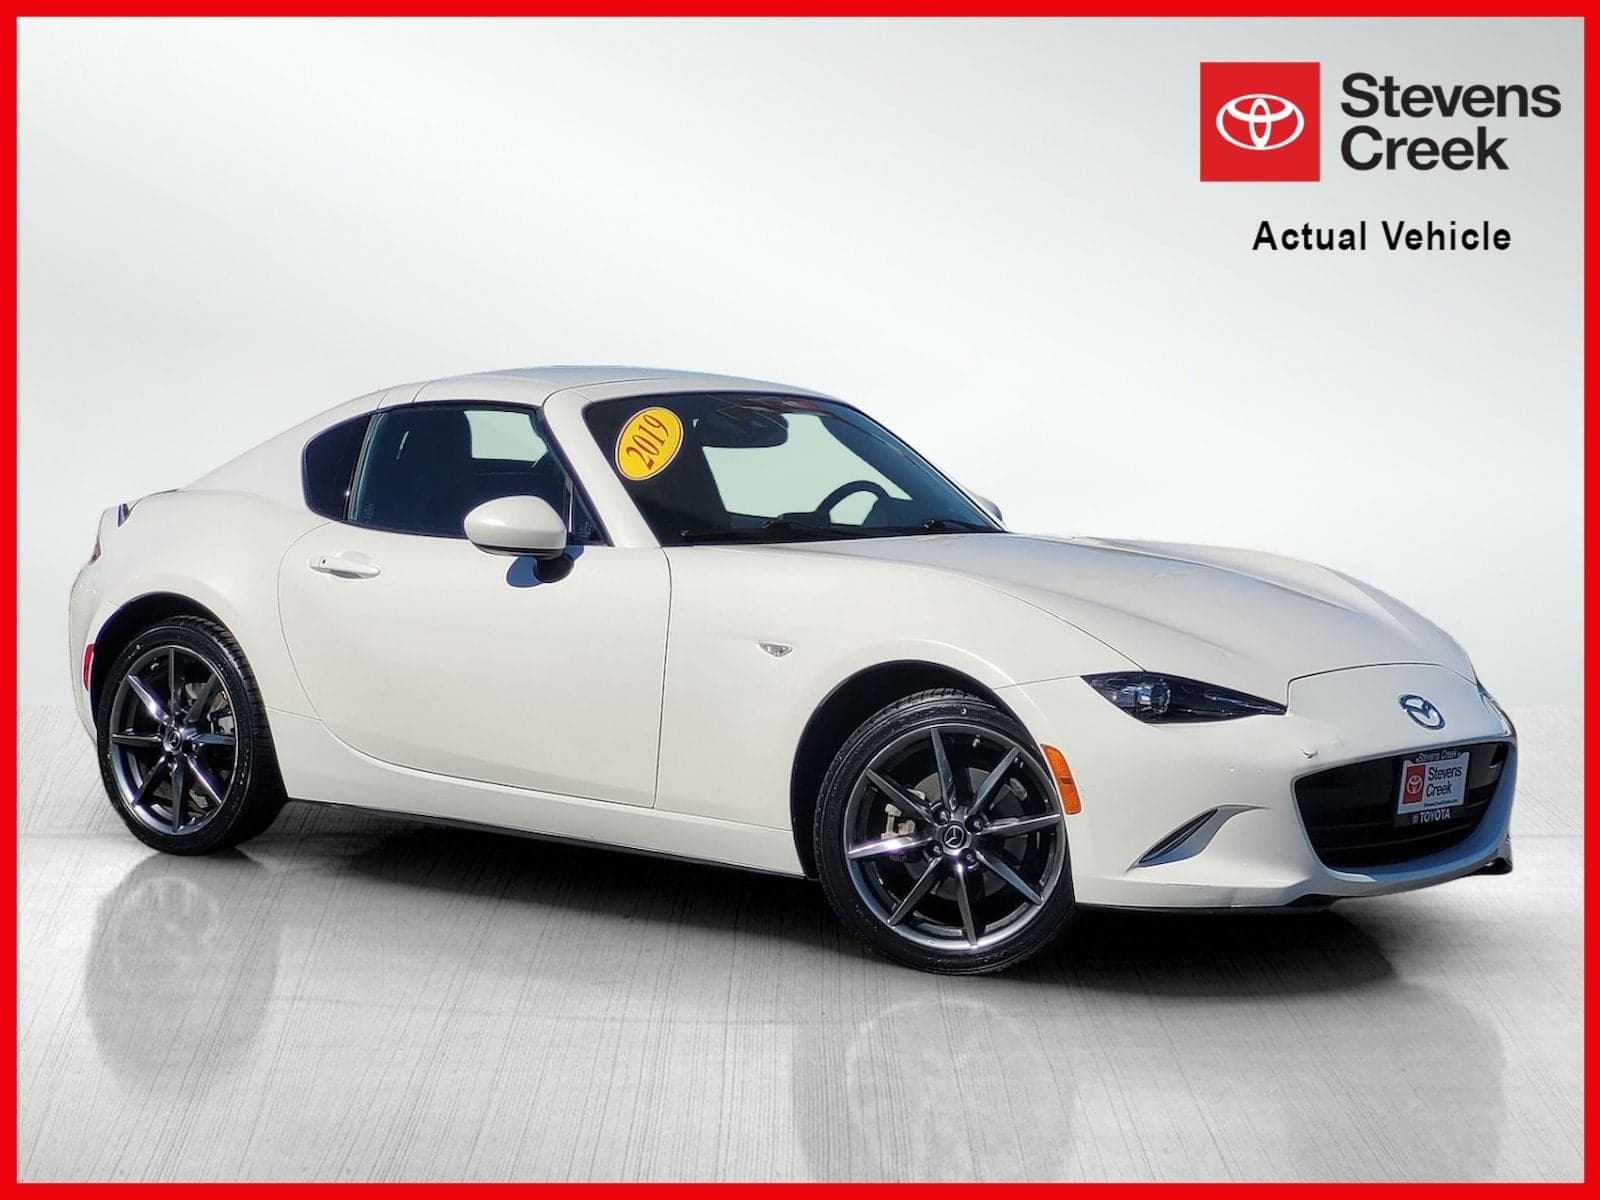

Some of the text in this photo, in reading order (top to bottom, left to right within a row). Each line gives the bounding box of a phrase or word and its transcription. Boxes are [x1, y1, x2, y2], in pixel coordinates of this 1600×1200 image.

[626, 414, 669, 471] 2019
[1428, 766, 1462, 781] Stevens
[1426, 781, 1452, 797] Creek
[1420, 808, 1451, 823] TOYOTA
